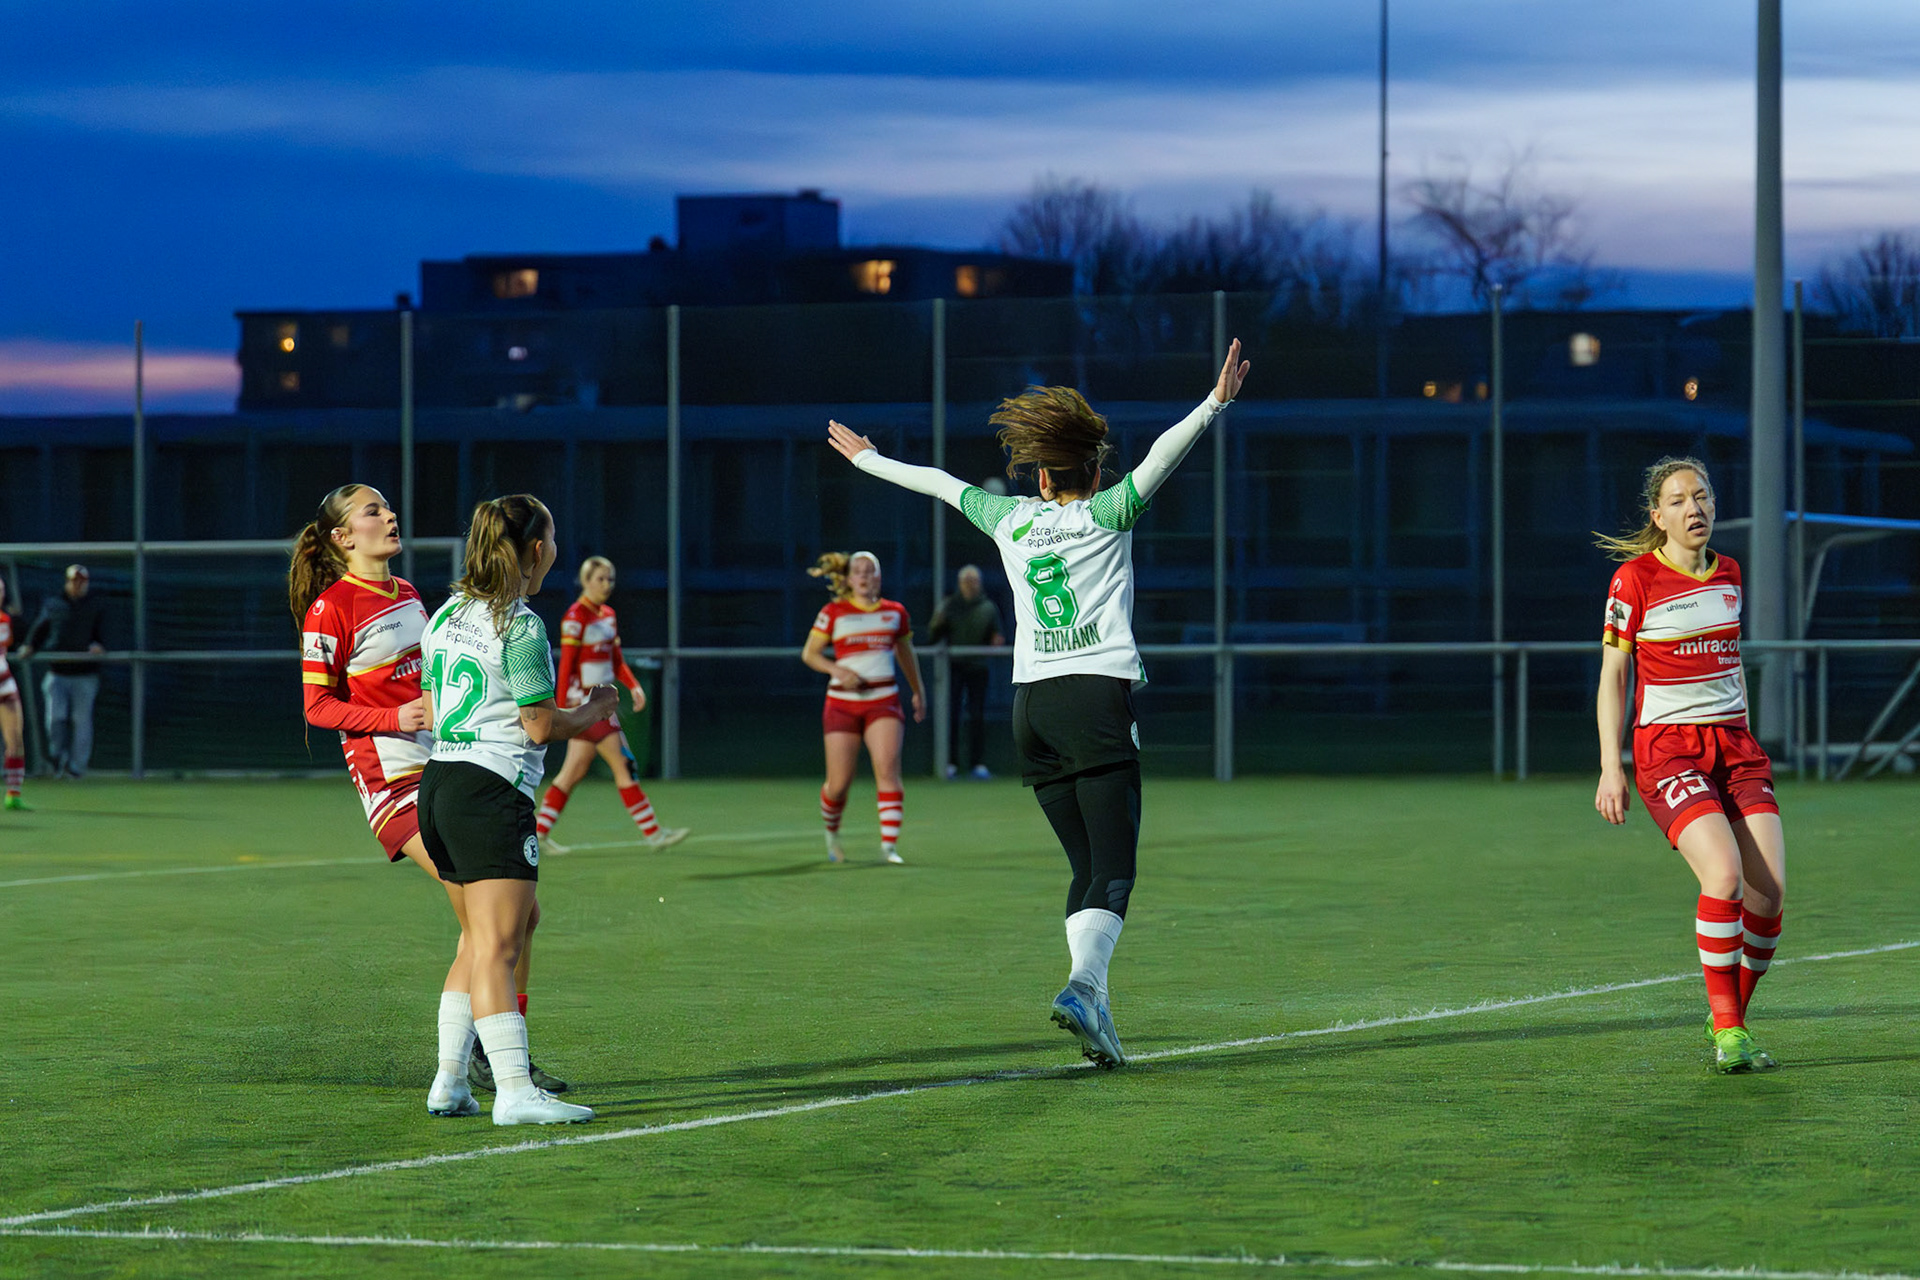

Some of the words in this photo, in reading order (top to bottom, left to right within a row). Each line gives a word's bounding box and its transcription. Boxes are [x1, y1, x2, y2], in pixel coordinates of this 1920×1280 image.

[1024, 552, 1079, 629] 8
[1666, 601, 1699, 612] uhlsport
[430, 649, 488, 742] 12
[1657, 769, 1710, 809] 25
